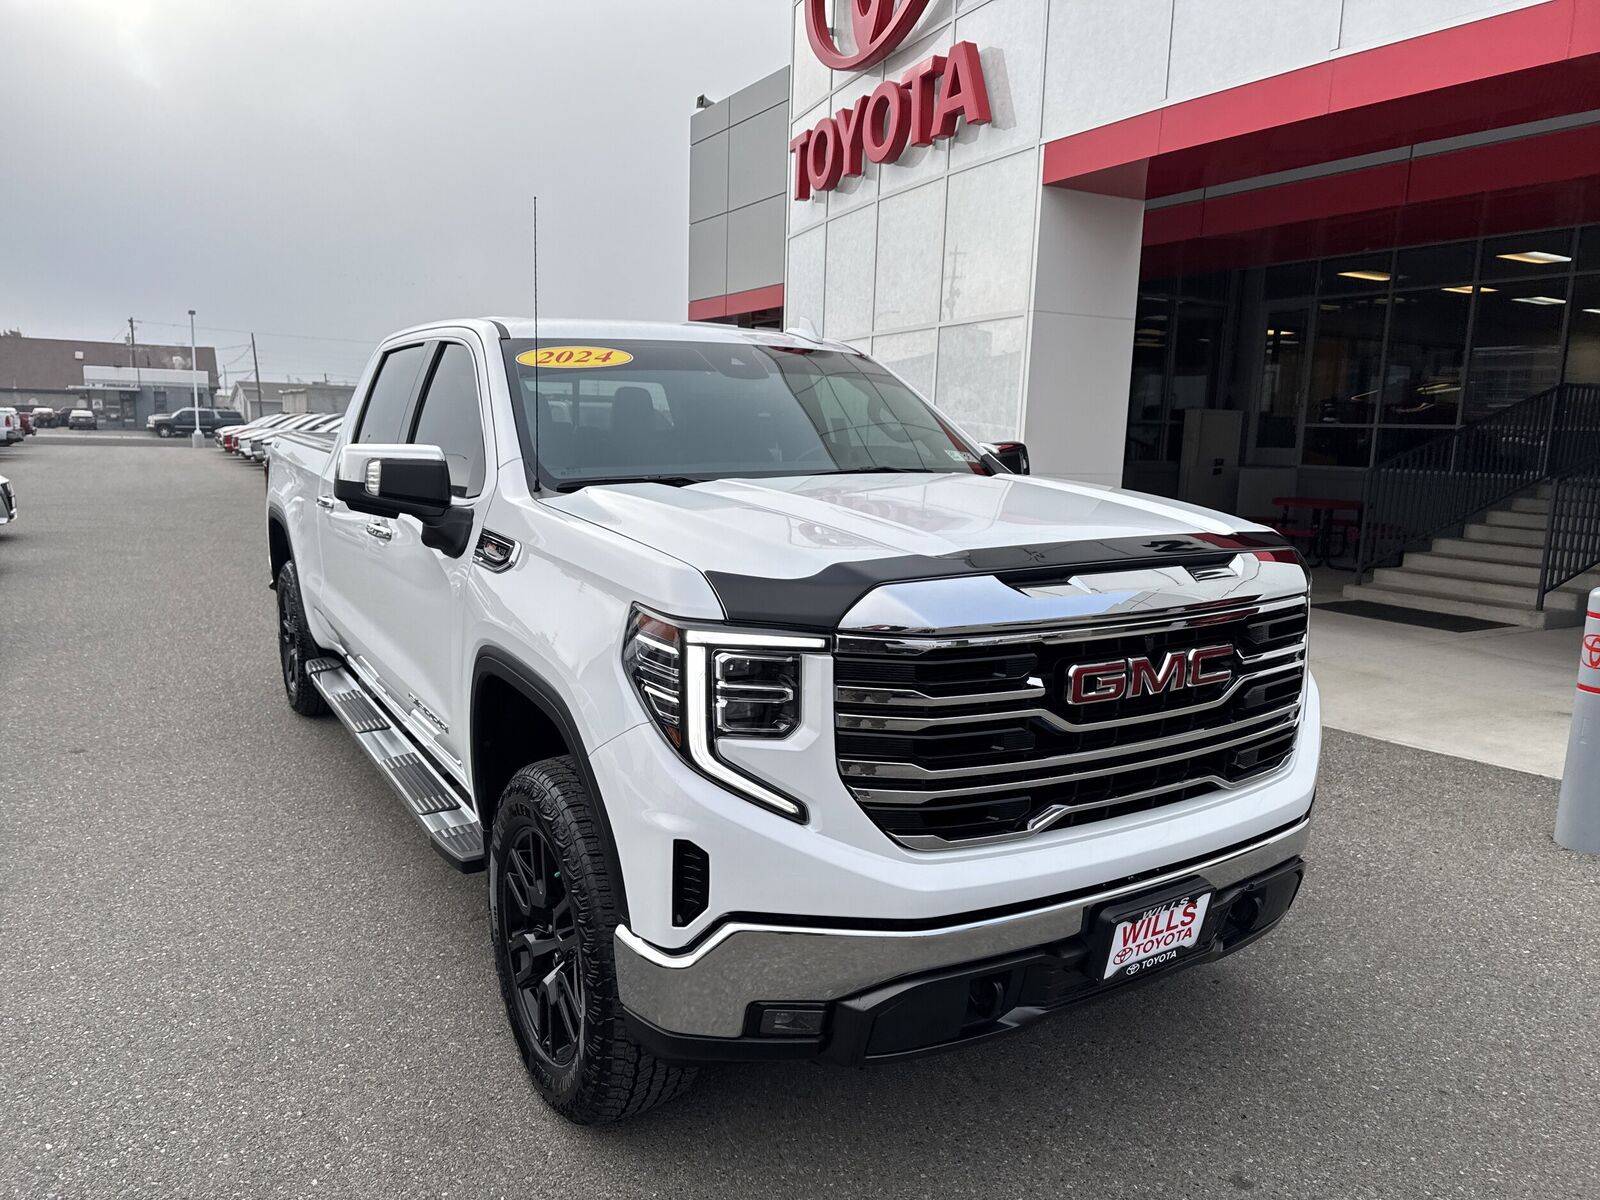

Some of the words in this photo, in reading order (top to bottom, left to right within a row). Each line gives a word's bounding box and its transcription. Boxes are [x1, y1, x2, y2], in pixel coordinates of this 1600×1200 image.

[790, 41, 992, 201] TOYOTA
[538, 350, 614, 364] 2024
[1066, 643, 1233, 705] GMC
[1142, 896, 1190, 919] WILLS
[1122, 903, 1198, 947] WILLS
[1135, 927, 1192, 956] TOYOTA
[1142, 950, 1177, 969] TOYOTA
